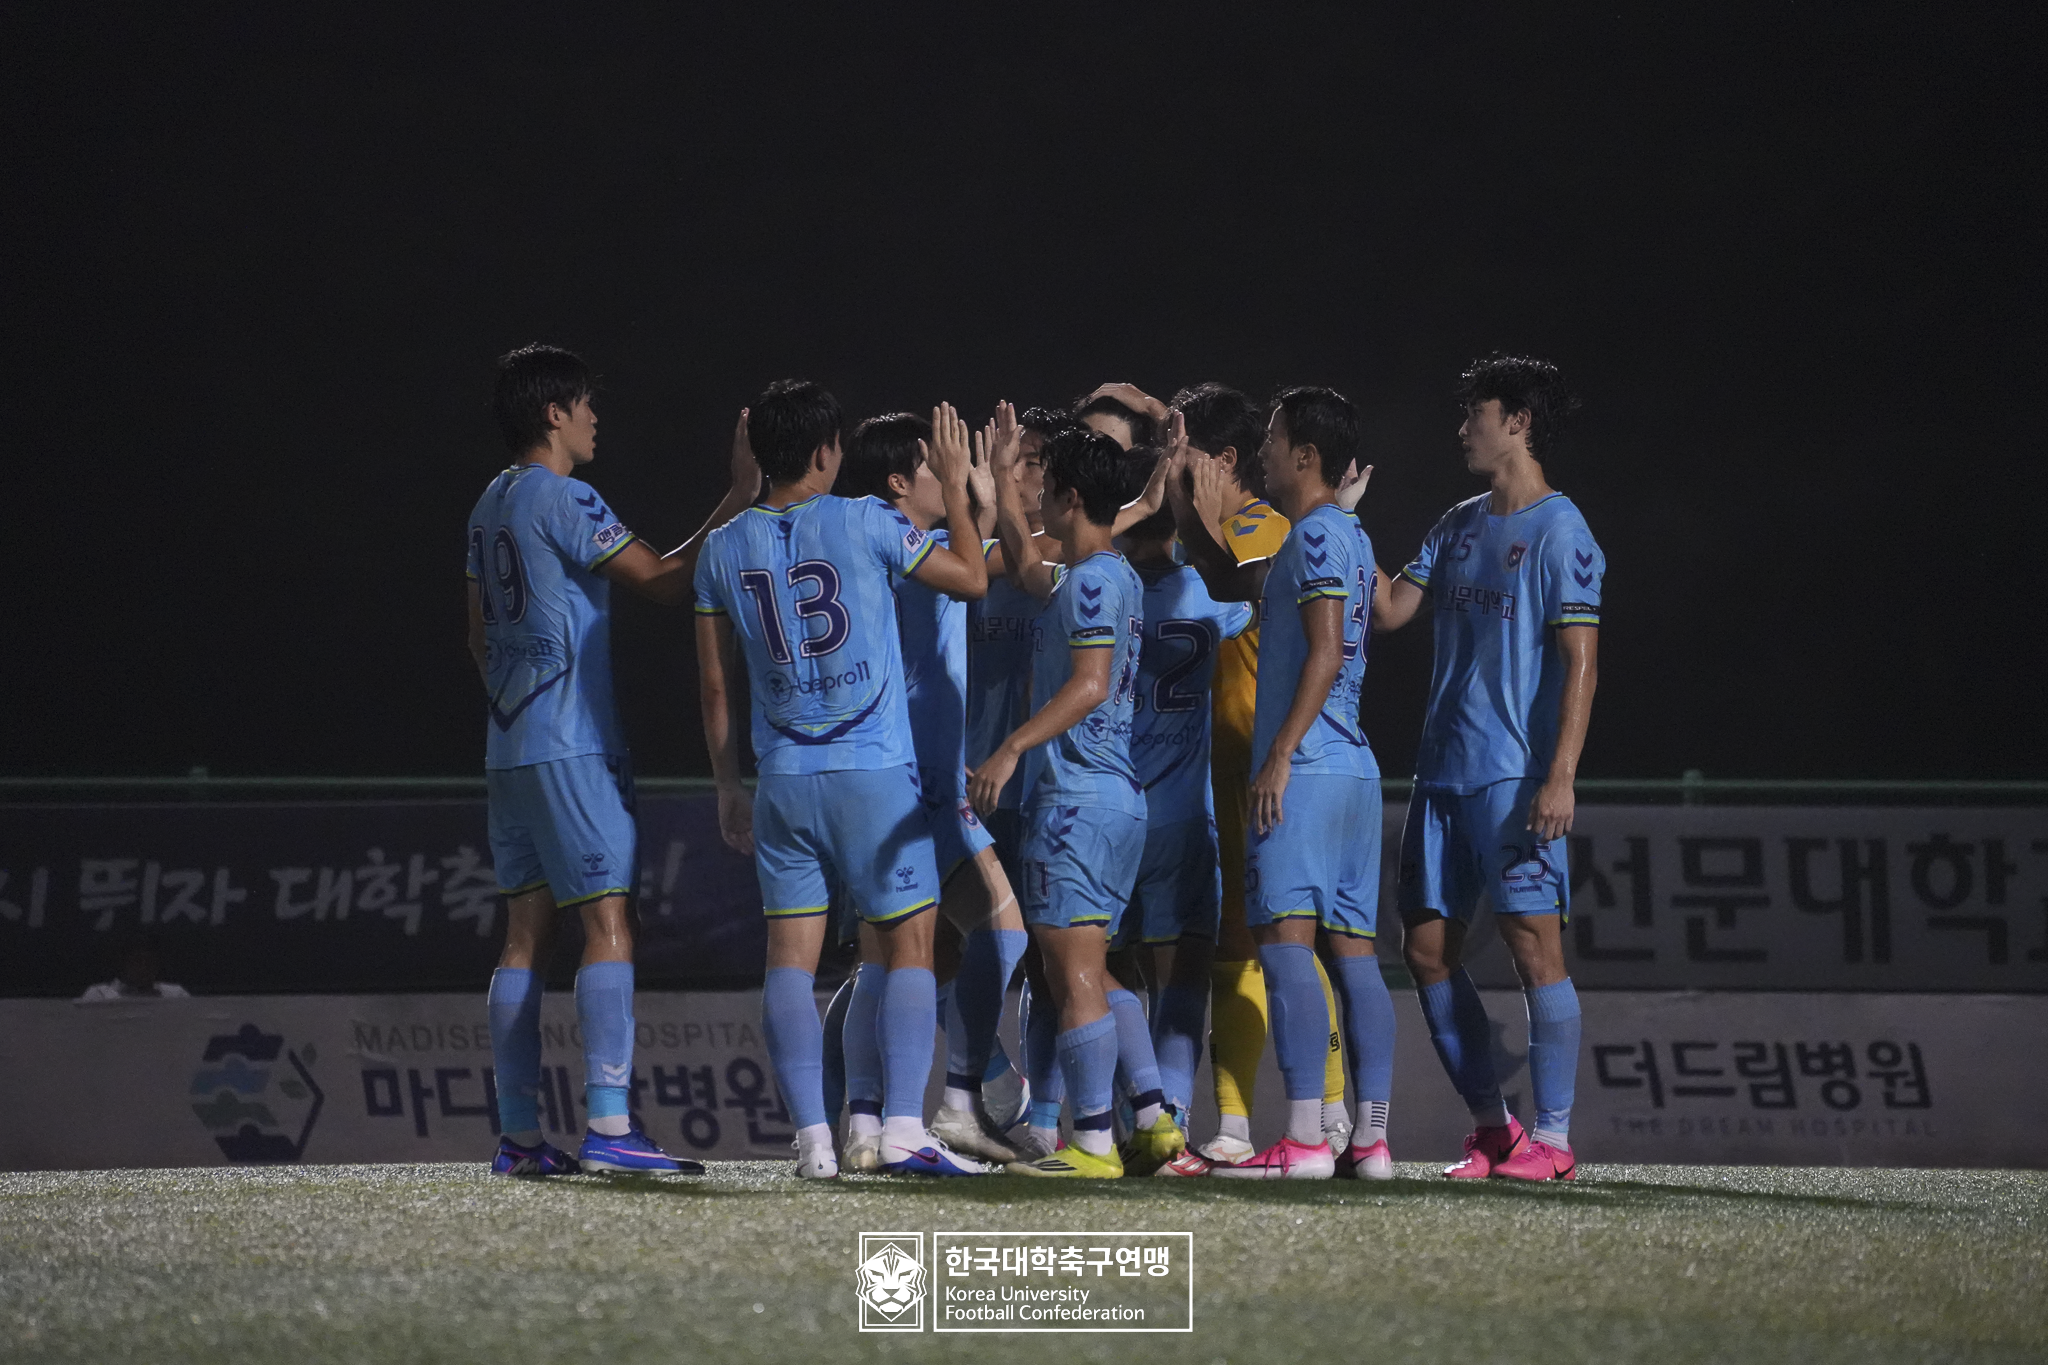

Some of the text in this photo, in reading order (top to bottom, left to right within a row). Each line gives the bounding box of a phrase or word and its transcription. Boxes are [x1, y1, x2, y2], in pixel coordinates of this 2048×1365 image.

[470, 525, 527, 625] 19
[739, 559, 851, 665] 13
[79, 857, 246, 932] 뛰자
[269, 845, 686, 937] 대학축!
[1500, 843, 1551, 883] 25
[1592, 1039, 1932, 1111] 더드림병원
[1611, 1116, 1937, 1138] THE DREAM HOSPITAL
